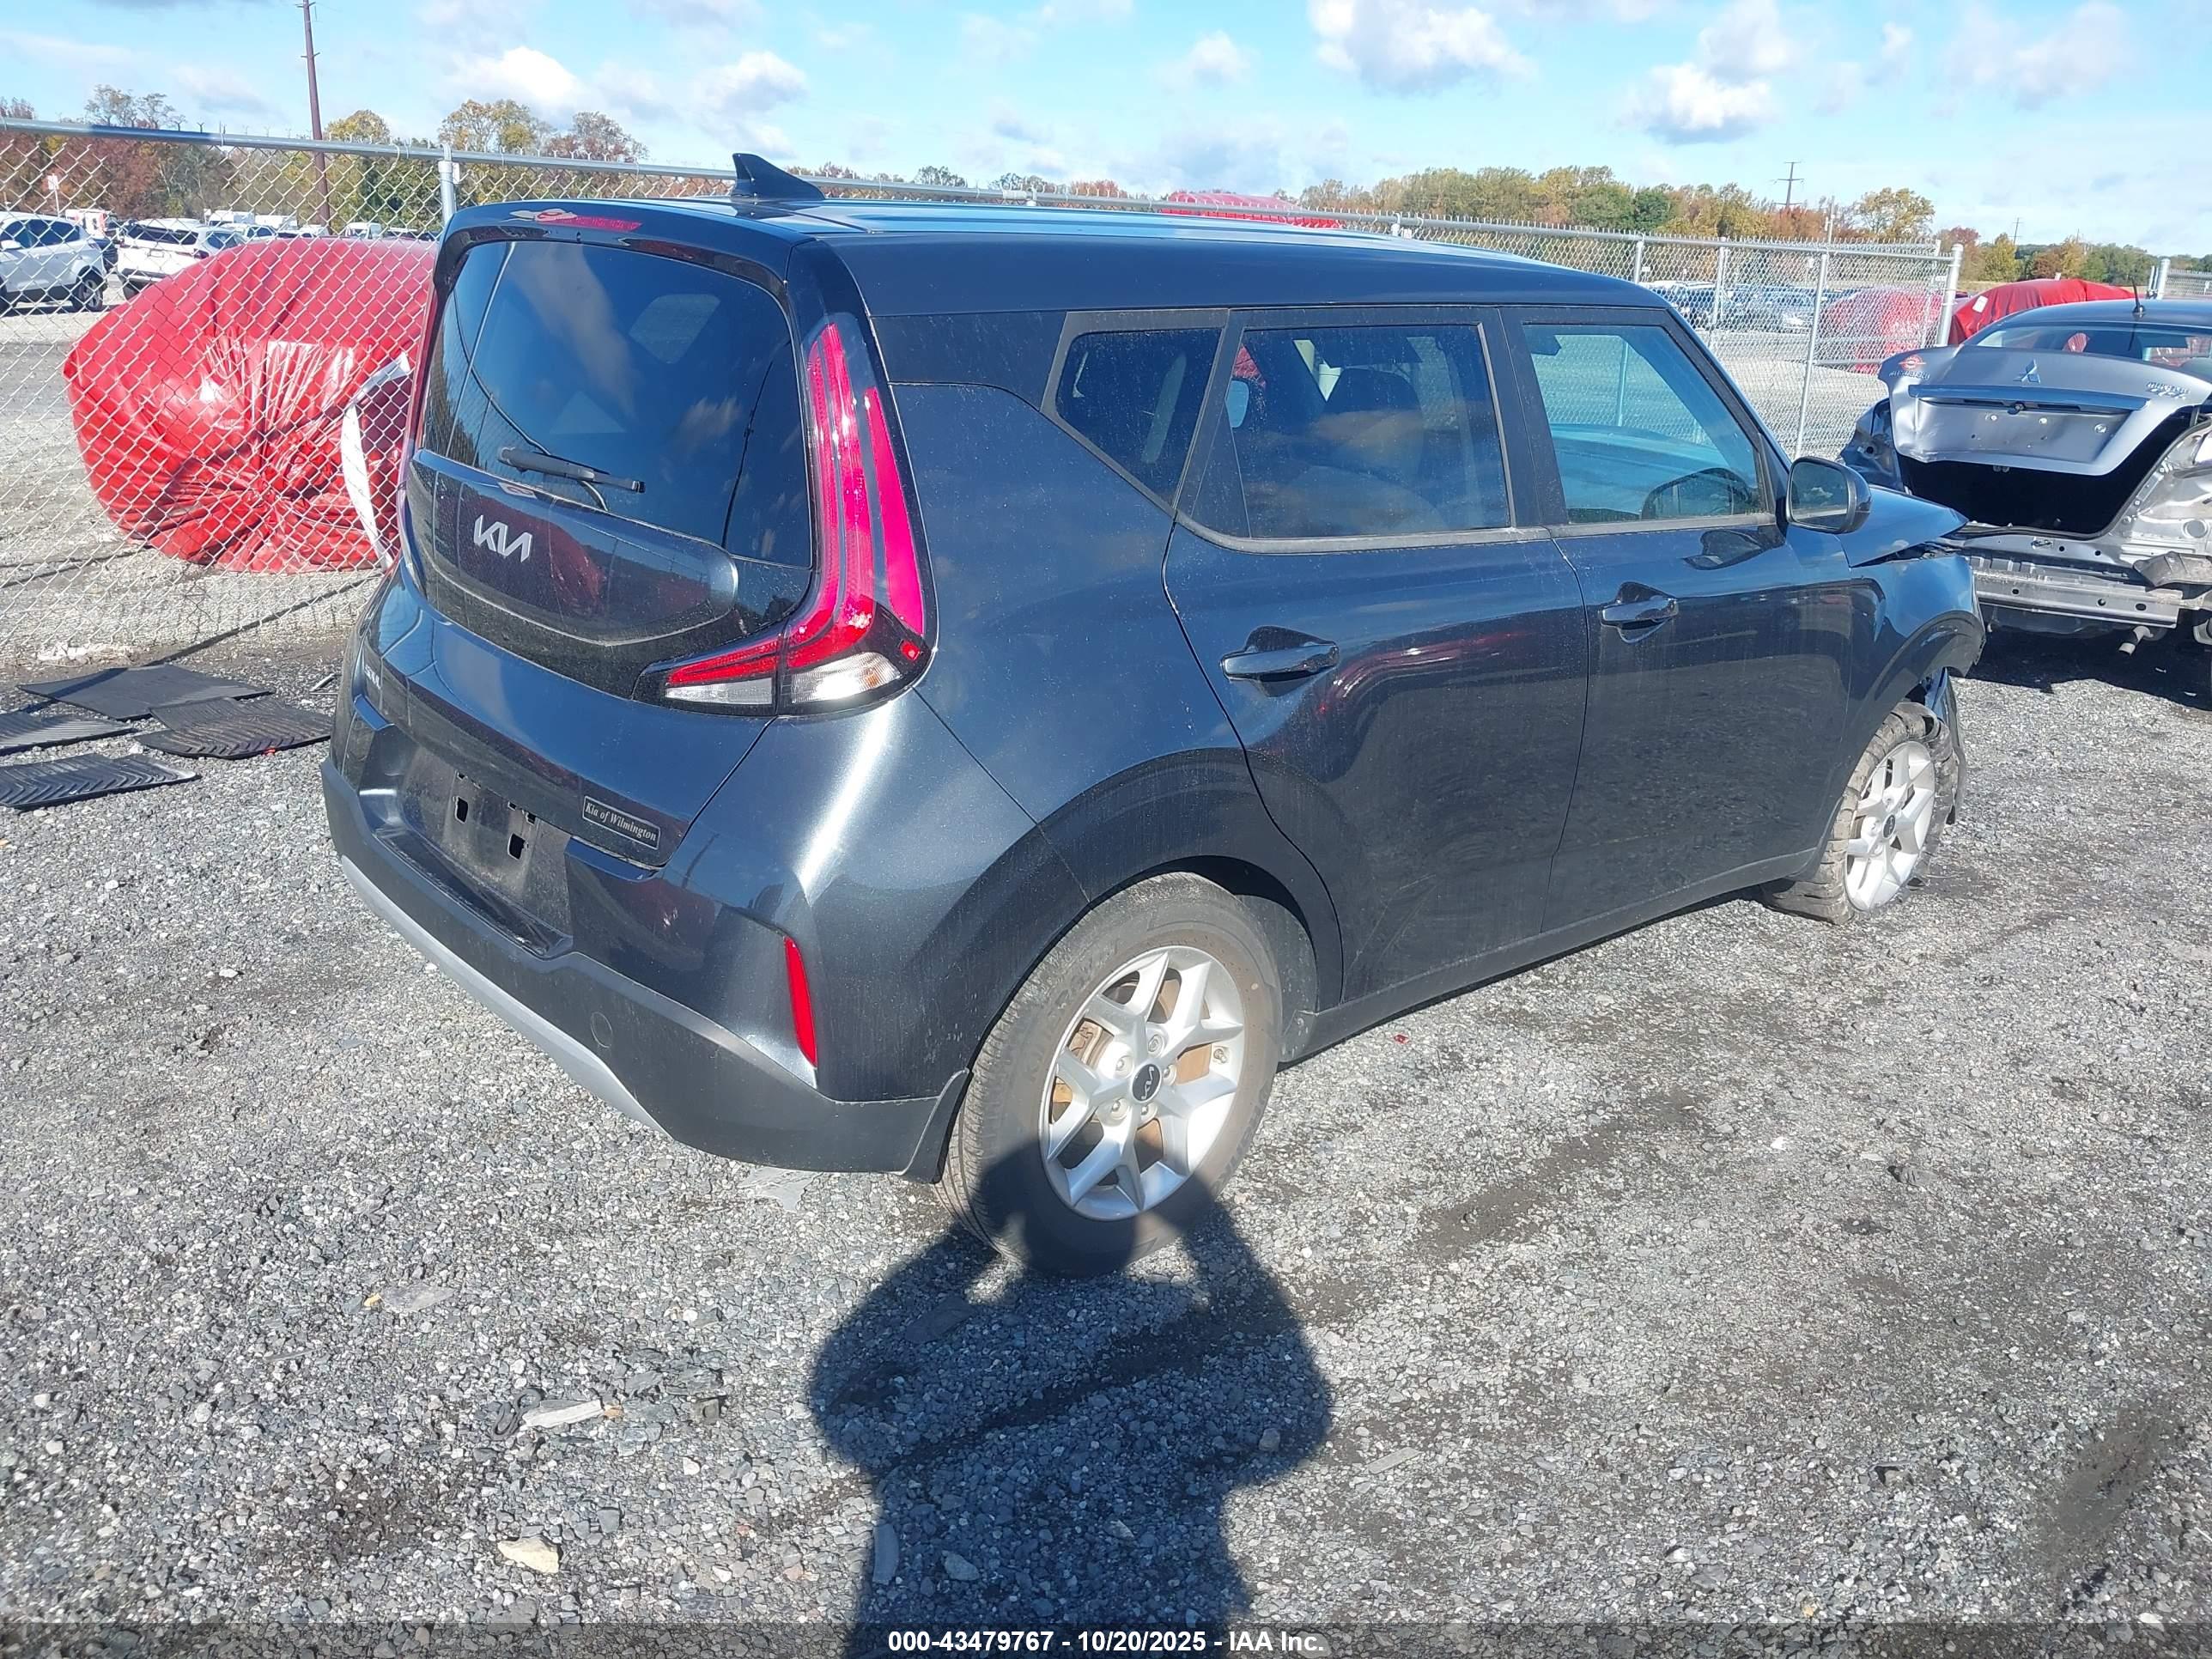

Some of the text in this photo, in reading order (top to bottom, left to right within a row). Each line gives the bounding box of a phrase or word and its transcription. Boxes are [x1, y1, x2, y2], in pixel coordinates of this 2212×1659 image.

[474, 514, 532, 563] KIA
[585, 802, 657, 842] Kia of Wilmington
